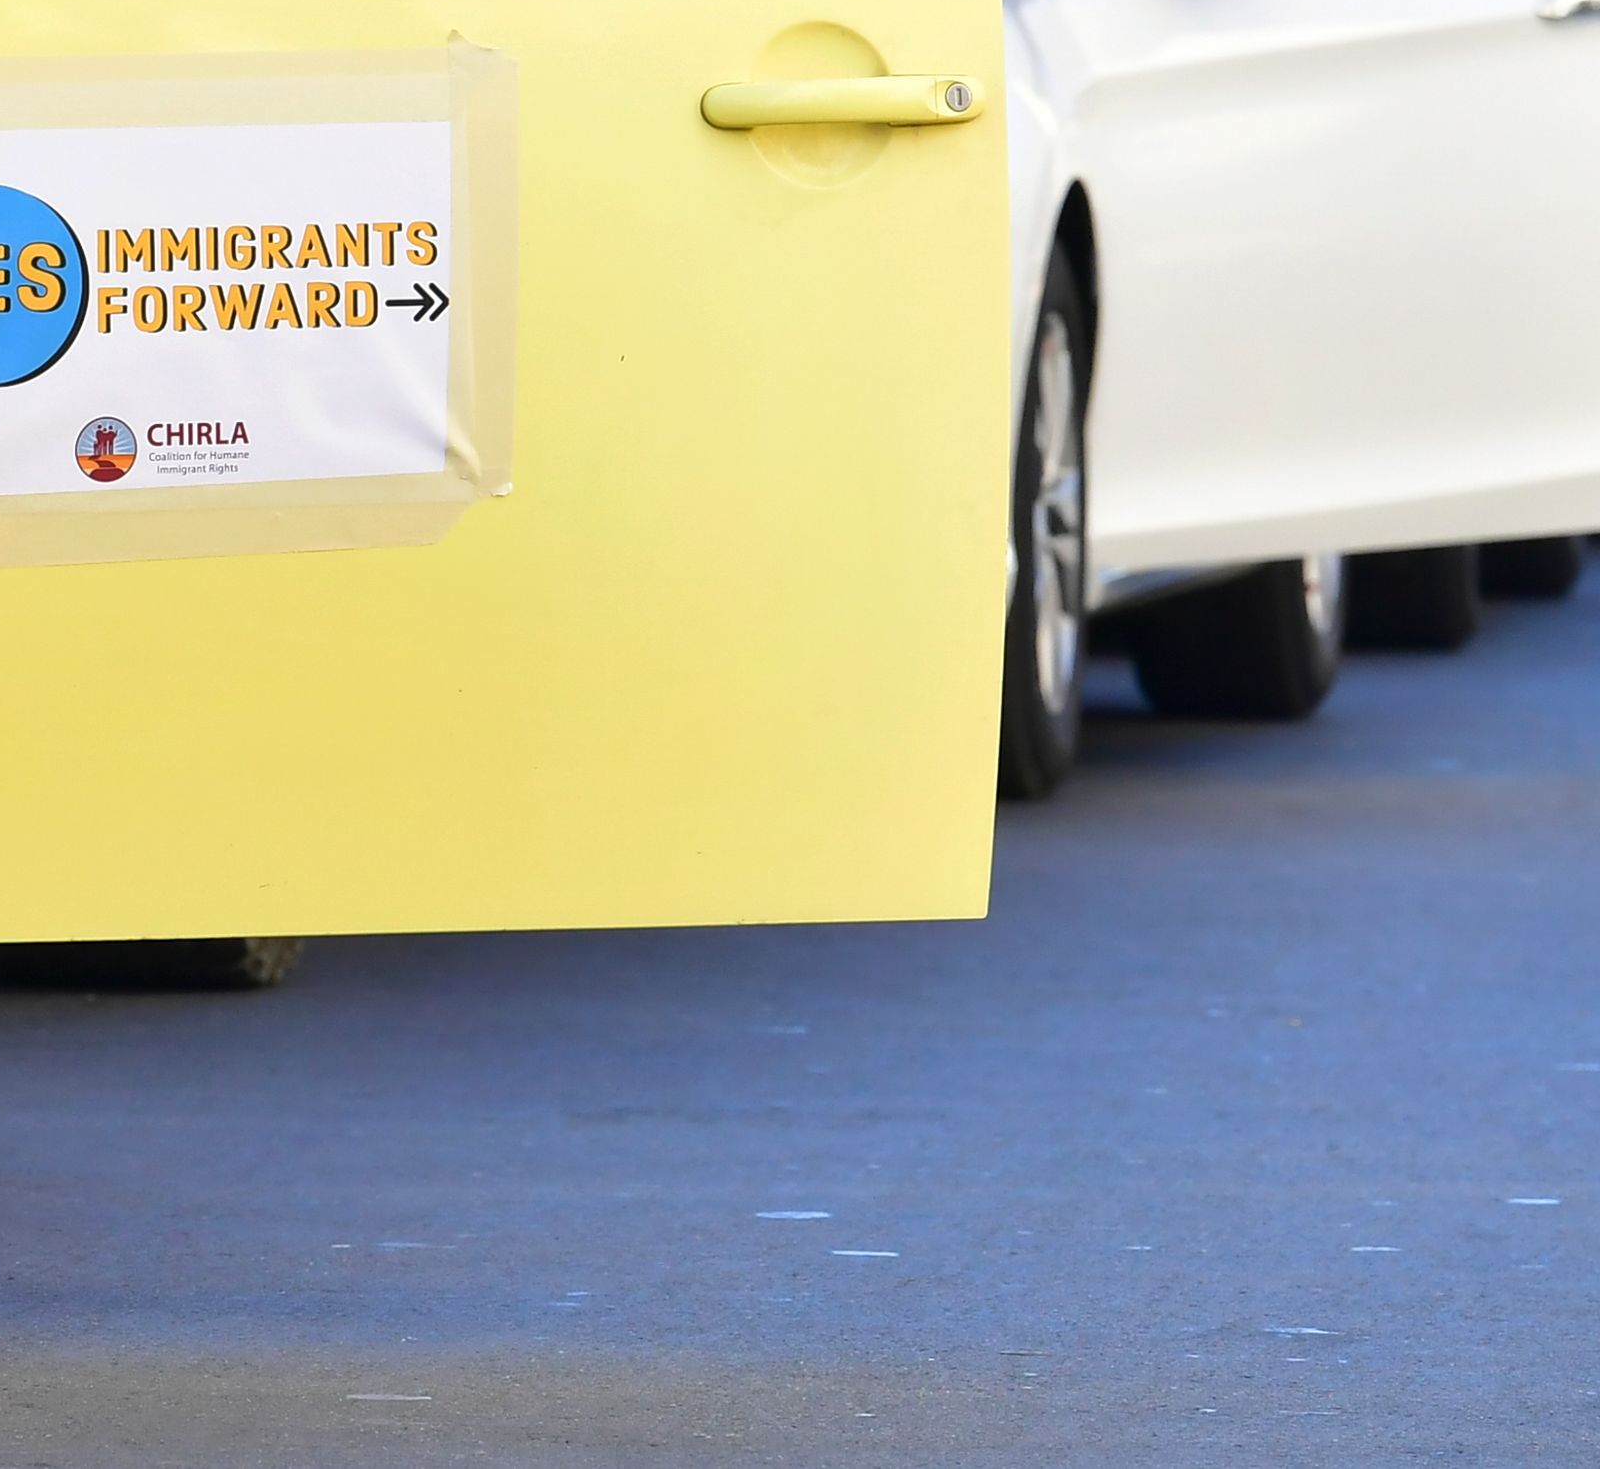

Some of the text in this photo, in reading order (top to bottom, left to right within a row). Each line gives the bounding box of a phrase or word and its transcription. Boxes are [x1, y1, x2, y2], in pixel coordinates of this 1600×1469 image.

[96, 221, 438, 273] IMMIGRANTS
[96, 281, 379, 333] FORWARD
[146, 421, 250, 447] CHIRLA
[148, 450, 250, 462] Coalition for Humane
[156, 463, 239, 476] Immigrant Rights
